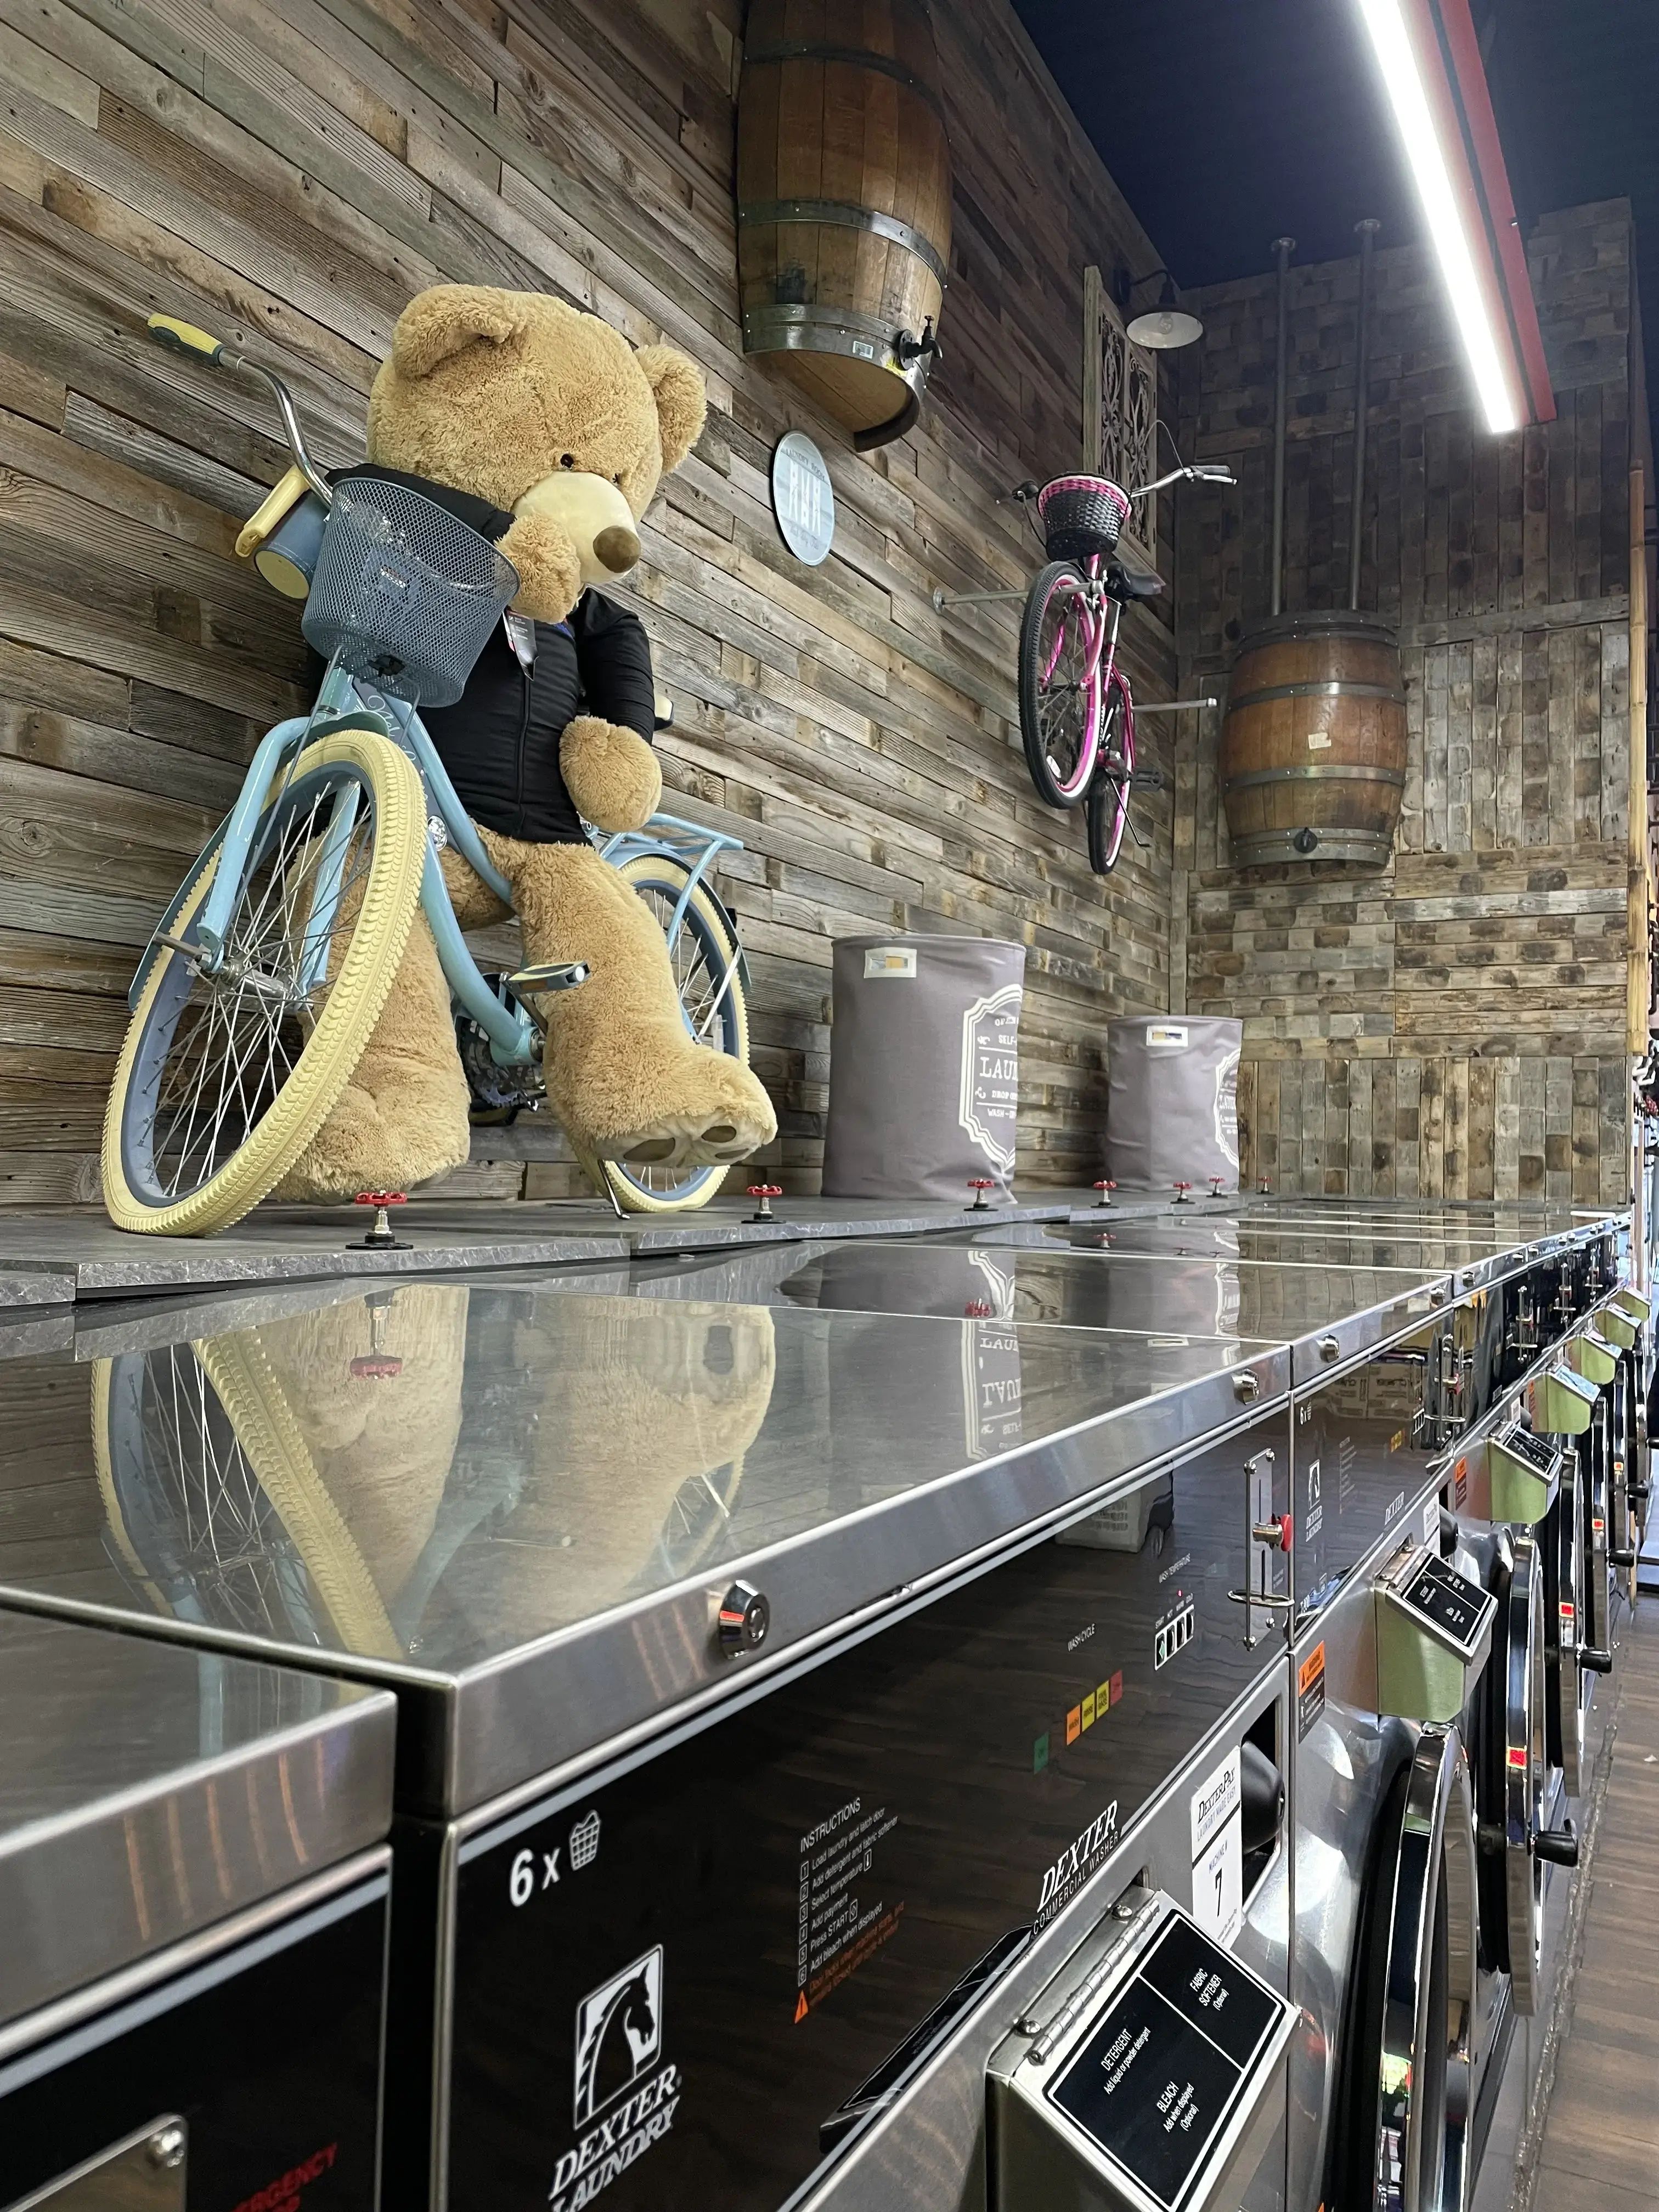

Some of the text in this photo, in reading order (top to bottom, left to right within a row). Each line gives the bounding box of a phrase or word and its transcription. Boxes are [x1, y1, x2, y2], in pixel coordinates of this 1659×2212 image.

[786, 448, 809, 466] LAUNDRY
[1080, 1623, 1096, 1643] CYCLE
[800, 1797, 861, 1853] INSTRUCTIONS
[1197, 1813, 1216, 1842] LAUNDRY
[1216, 1797, 1227, 1819] MADE
[812, 1850, 827, 1870] Load
[827, 1836, 848, 1859] laundry
[849, 1827, 860, 1842] and
[812, 1875, 824, 1891] Add
[825, 1852, 851, 1881] detergent
[851, 1842, 862, 1859] and
[1037, 1799, 1118, 1914] DEXTER
[509, 1847, 561, 1907] 6 x
[811, 1888, 830, 1910] Select
[830, 1863, 864, 1895] temperature
[1033, 1830, 1118, 1936] COMMERCIAL WASHER
[1215, 1866, 1222, 1918] 7
[810, 1931, 827, 1953] Press
[827, 1910, 849, 1937] START
[811, 1916, 824, 1931] Add
[824, 1892, 848, 1921] payment
[810, 1956, 823, 1973] Add
[823, 1937, 842, 1962] bleach
[842, 1924, 857, 1944] when
[857, 1900, 883, 1930] displayed
[1189, 1967, 1208, 1992] FABRIC
[1198, 1973, 1222, 2007] SOFTENER
[1212, 1988, 1230, 2011] (Optional)
[1101, 2028, 1132, 2072] DETERGENT
[1103, 2026, 1151, 2095] Add liquid or powder detergent
[1156, 2080, 1179, 2113] BLEACH
[1163, 2082, 1194, 2133] Add when displayed
[1180, 2103, 1200, 2132] (Optional)
[549, 2063, 677, 2200] DEXTER
